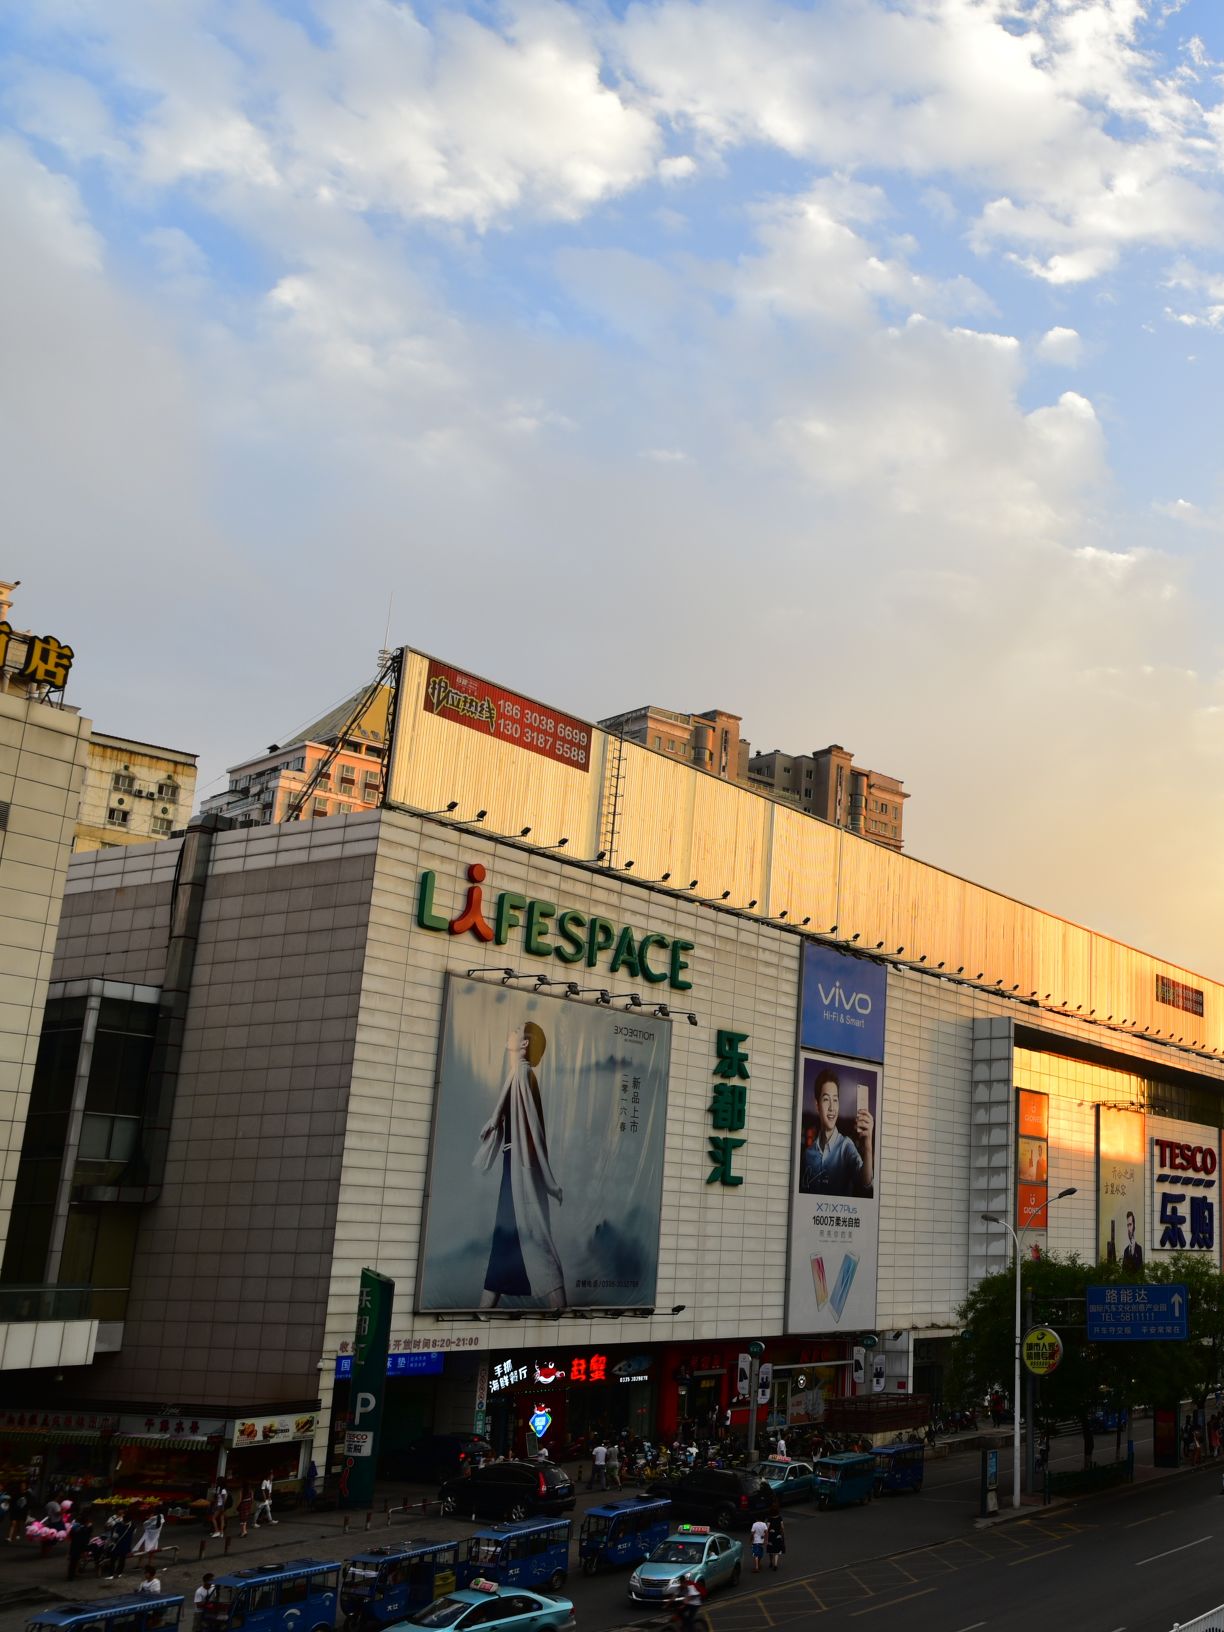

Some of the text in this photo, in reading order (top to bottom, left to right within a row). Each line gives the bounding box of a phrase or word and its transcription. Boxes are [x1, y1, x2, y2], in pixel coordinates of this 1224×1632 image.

[0, 621, 74, 689] 店
[498, 700, 588, 746] 186 3038 6699
[498, 719, 586, 763] 130 3187 5588
[818, 981, 872, 1015] vivo
[823, 1010, 865, 1028] Hi-Fi & Smart
[630, 1077, 641, 1134] 新品上市
[706, 1029, 750, 1186] 乐都汇
[1155, 1139, 1217, 1175] TESCO
[812, 1216, 861, 1228] 1600万柔光自拍
[1160, 1192, 1214, 1249] 乐购
[1105, 1289, 1149, 1303] 路能达
[1025, 1342, 1056, 1351] 城市人家
[489, 1366, 528, 1393] 海鲜餐厅
[494, 1359, 513, 1378] 手抓
[354, 1392, 376, 1426] P
